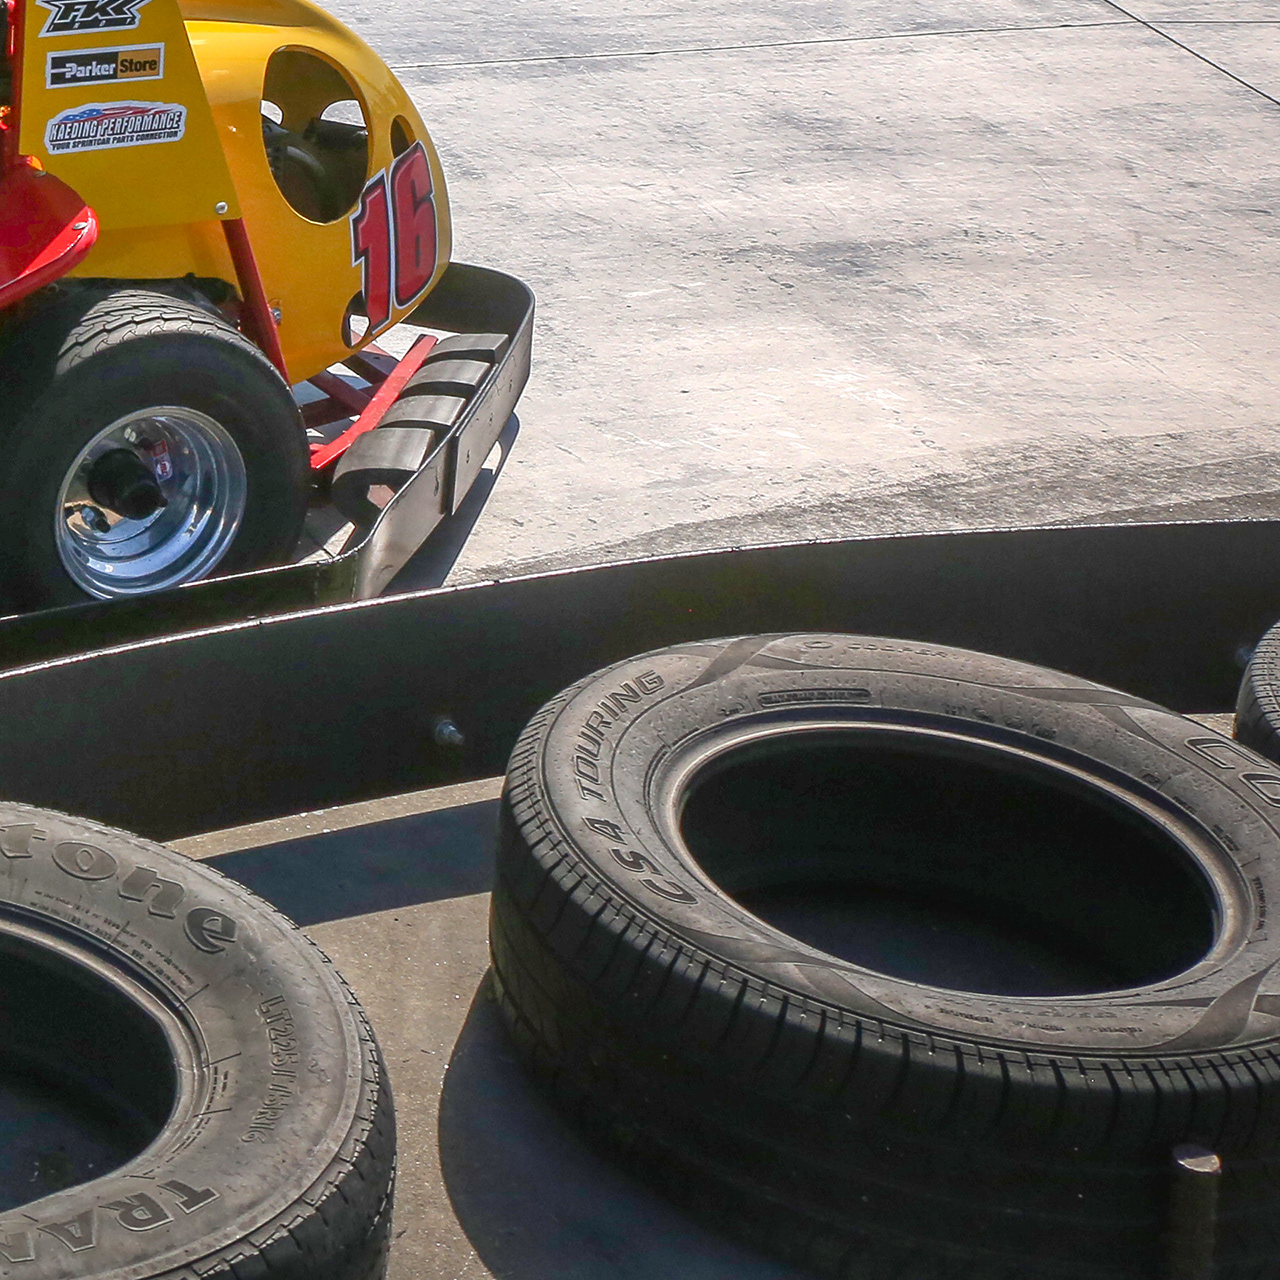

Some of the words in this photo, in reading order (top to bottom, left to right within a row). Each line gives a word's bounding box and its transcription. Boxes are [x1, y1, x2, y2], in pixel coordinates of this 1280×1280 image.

[65, 62, 116, 80] Parker
[119, 57, 159, 73] Store
[49, 120, 98, 141] KAEDING
[100, 111, 182, 136] PERFORMANCE
[72, 139, 111, 149] SPRINTCAR
[112, 136, 134, 145] PARTS
[349, 139, 439, 335] 16
[577, 669, 667, 803] TOURING
